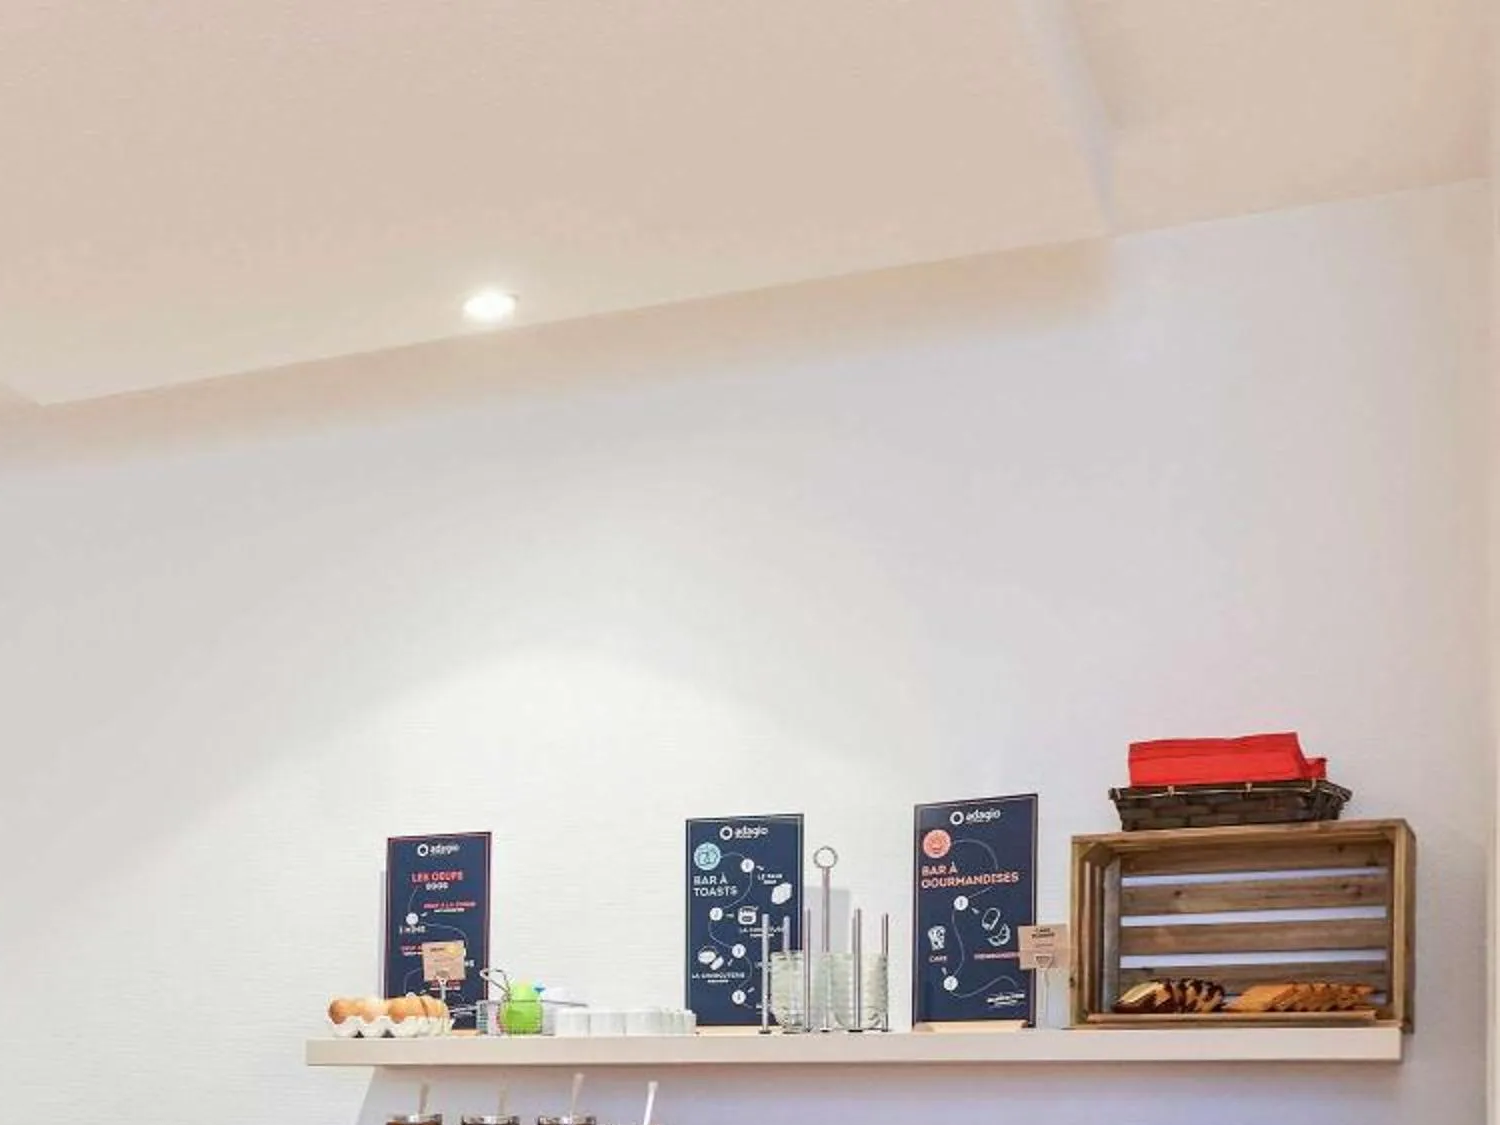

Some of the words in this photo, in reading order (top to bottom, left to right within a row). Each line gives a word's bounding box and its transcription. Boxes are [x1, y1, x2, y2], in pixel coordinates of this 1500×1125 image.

[965, 808, 1001, 823] adagio
[922, 866, 947, 876] BAR
[693, 875, 717, 885] BAR
[921, 871, 1020, 889] GOURMANDISES
[693, 886, 738, 897] TOASTS
